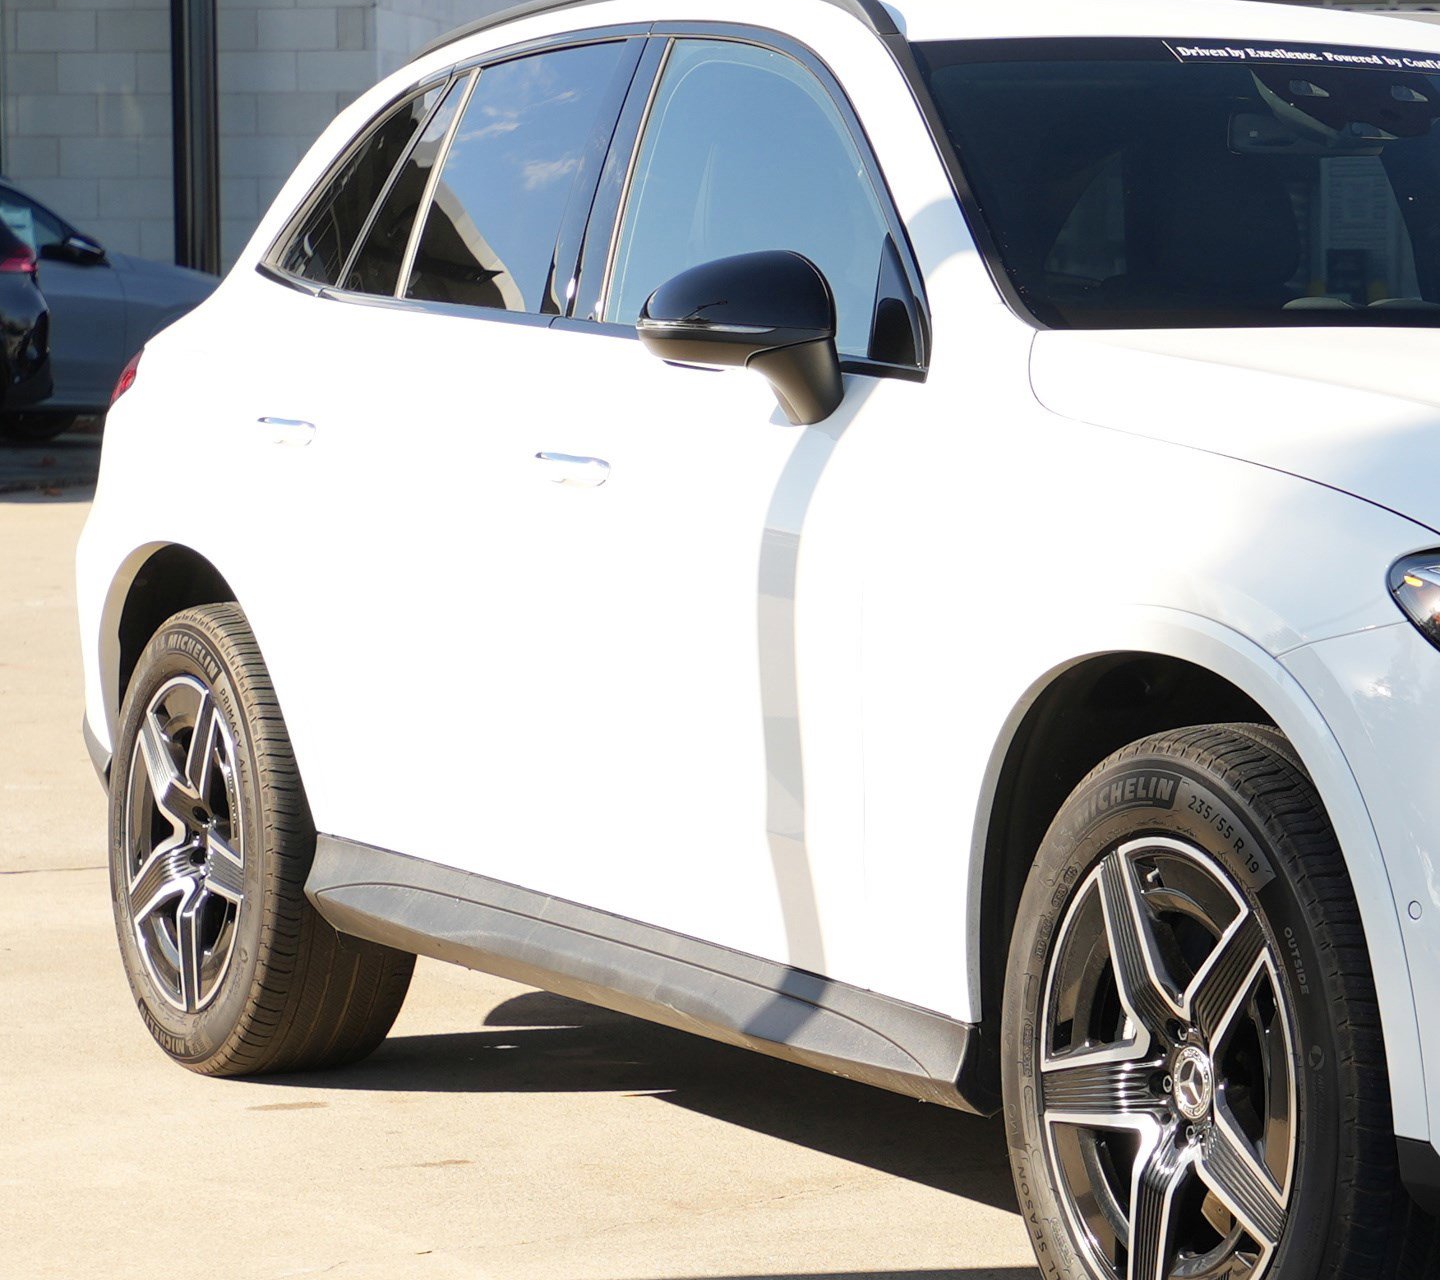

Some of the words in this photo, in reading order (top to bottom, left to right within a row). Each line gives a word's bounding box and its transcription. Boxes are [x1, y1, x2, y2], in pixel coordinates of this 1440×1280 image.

[1177, 46, 1229, 58] Driven
[1229, 47, 1245, 60] by
[1247, 48, 1322, 61] Excellence.
[1322, 51, 1383, 65] Powered
[1385, 54, 1402, 68] by
[167, 633, 219, 679] MICHELIN
[219, 687, 242, 749] PRIMACY
[1073, 775, 1176, 828] MICHELIN
[1187, 795, 1234, 839] 235/55
[1233, 837, 1245, 854] R
[1244, 853, 1260, 874] 19
[1283, 926, 1310, 995] OUTSIDE
[1017, 1166, 1048, 1253] SEASON
